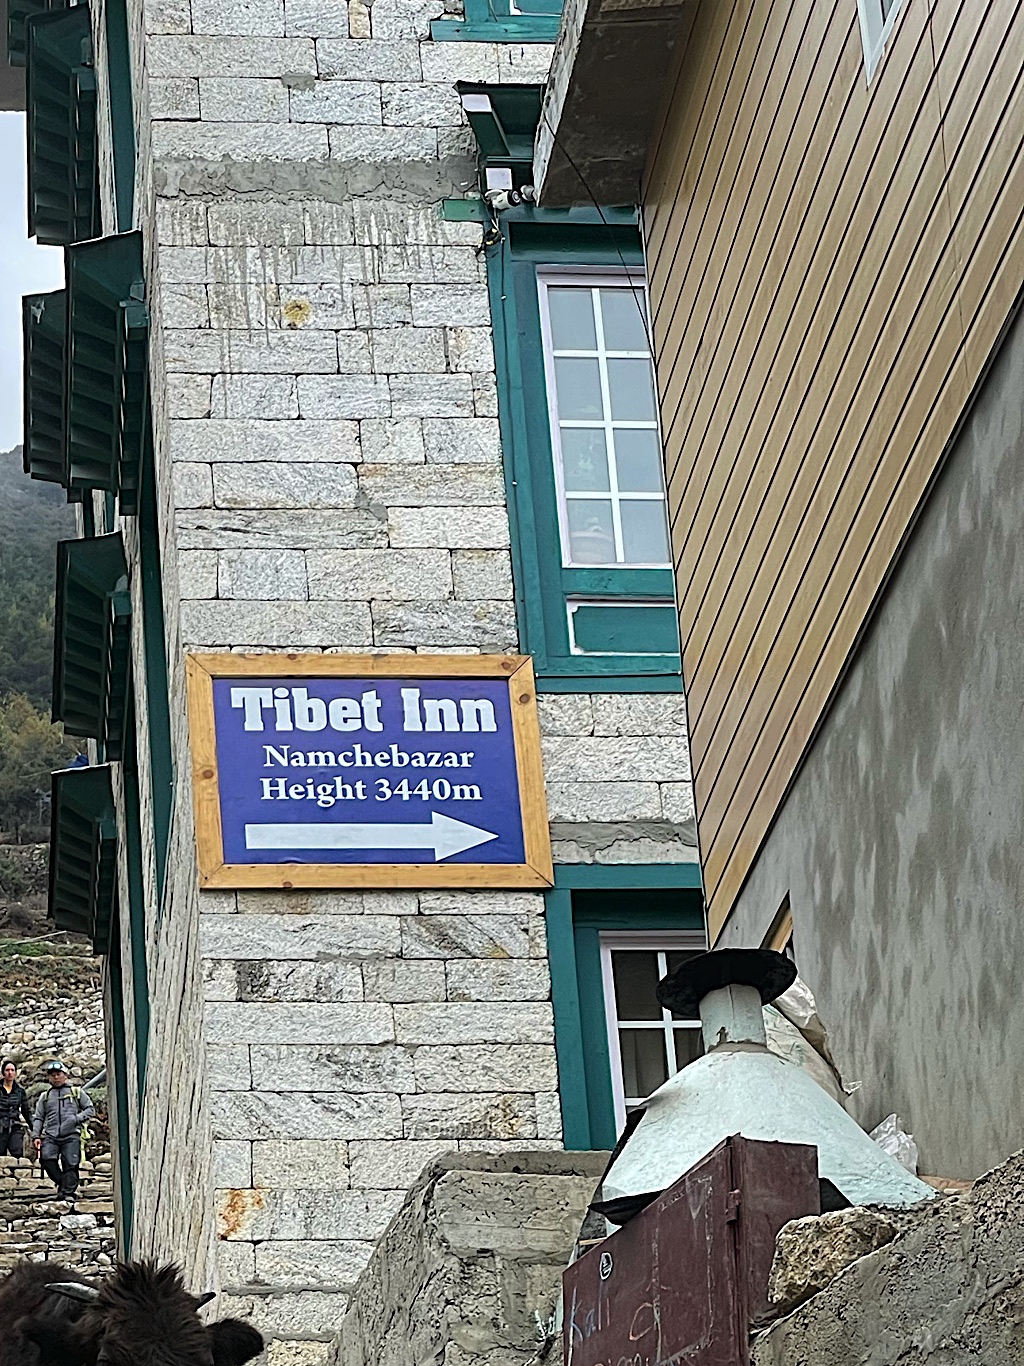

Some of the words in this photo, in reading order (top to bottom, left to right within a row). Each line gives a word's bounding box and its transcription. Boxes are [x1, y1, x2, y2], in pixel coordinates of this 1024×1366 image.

[230, 687, 384, 732] Tibet
[400, 687, 498, 732] Inn
[262, 743, 475, 769] Namchebazar
[260, 776, 367, 808] Height
[374, 778, 483, 801] 3440m
